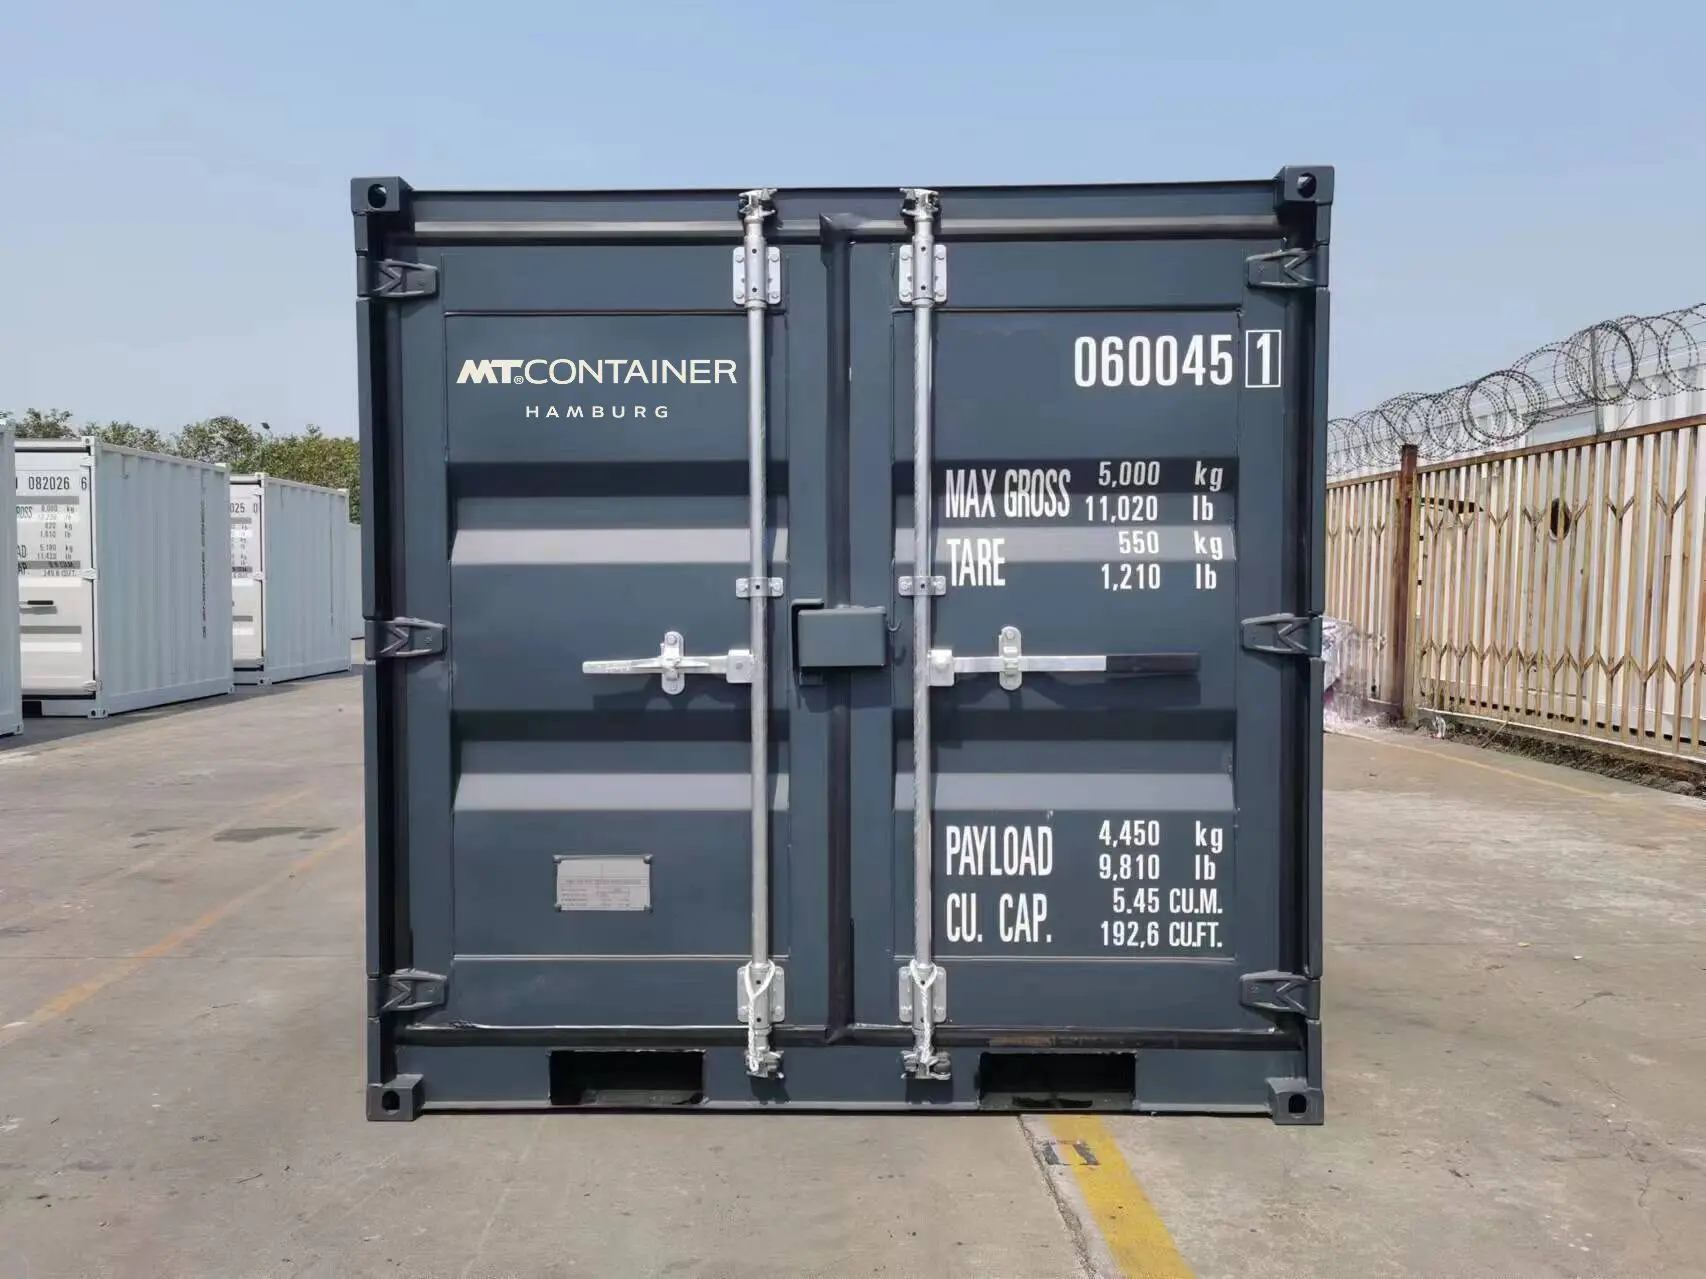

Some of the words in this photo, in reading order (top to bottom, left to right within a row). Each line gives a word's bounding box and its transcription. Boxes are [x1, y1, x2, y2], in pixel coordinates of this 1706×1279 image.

[1074, 334, 1233, 387] 060045
[1255, 333, 1271, 385] 1
[526, 405, 668, 418] HAMBURG
[28, 476, 70, 490] 082026
[81, 476, 87, 490] 6
[946, 469, 996, 518] MAX
[1004, 468, 1071, 518] GROSS
[1098, 461, 1160, 487] 5,000
[1194, 460, 1224, 492] kg
[1085, 495, 1158, 523] 11,020
[1193, 495, 1214, 521] lb
[946, 537, 1006, 586] TARE
[1118, 530, 1159, 554] 550
[1194, 530, 1223, 560] kg
[1101, 563, 1160, 591] 1,210
[1195, 563, 1217, 589] lb
[946, 825, 1053, 876] PAYLOAD
[1098, 820, 1160, 847] 4,450
[1195, 820, 1223, 853] kg
[1099, 854, 1160, 881] 9,810
[1195, 854, 1216, 880] lb
[946, 893, 983, 942] CU.
[999, 893, 1052, 943] CAP.
[1113, 888, 1160, 913] 5.45
[1169, 888, 1223, 914] CU.M.
[1168, 921, 1223, 947] CU.FT.
